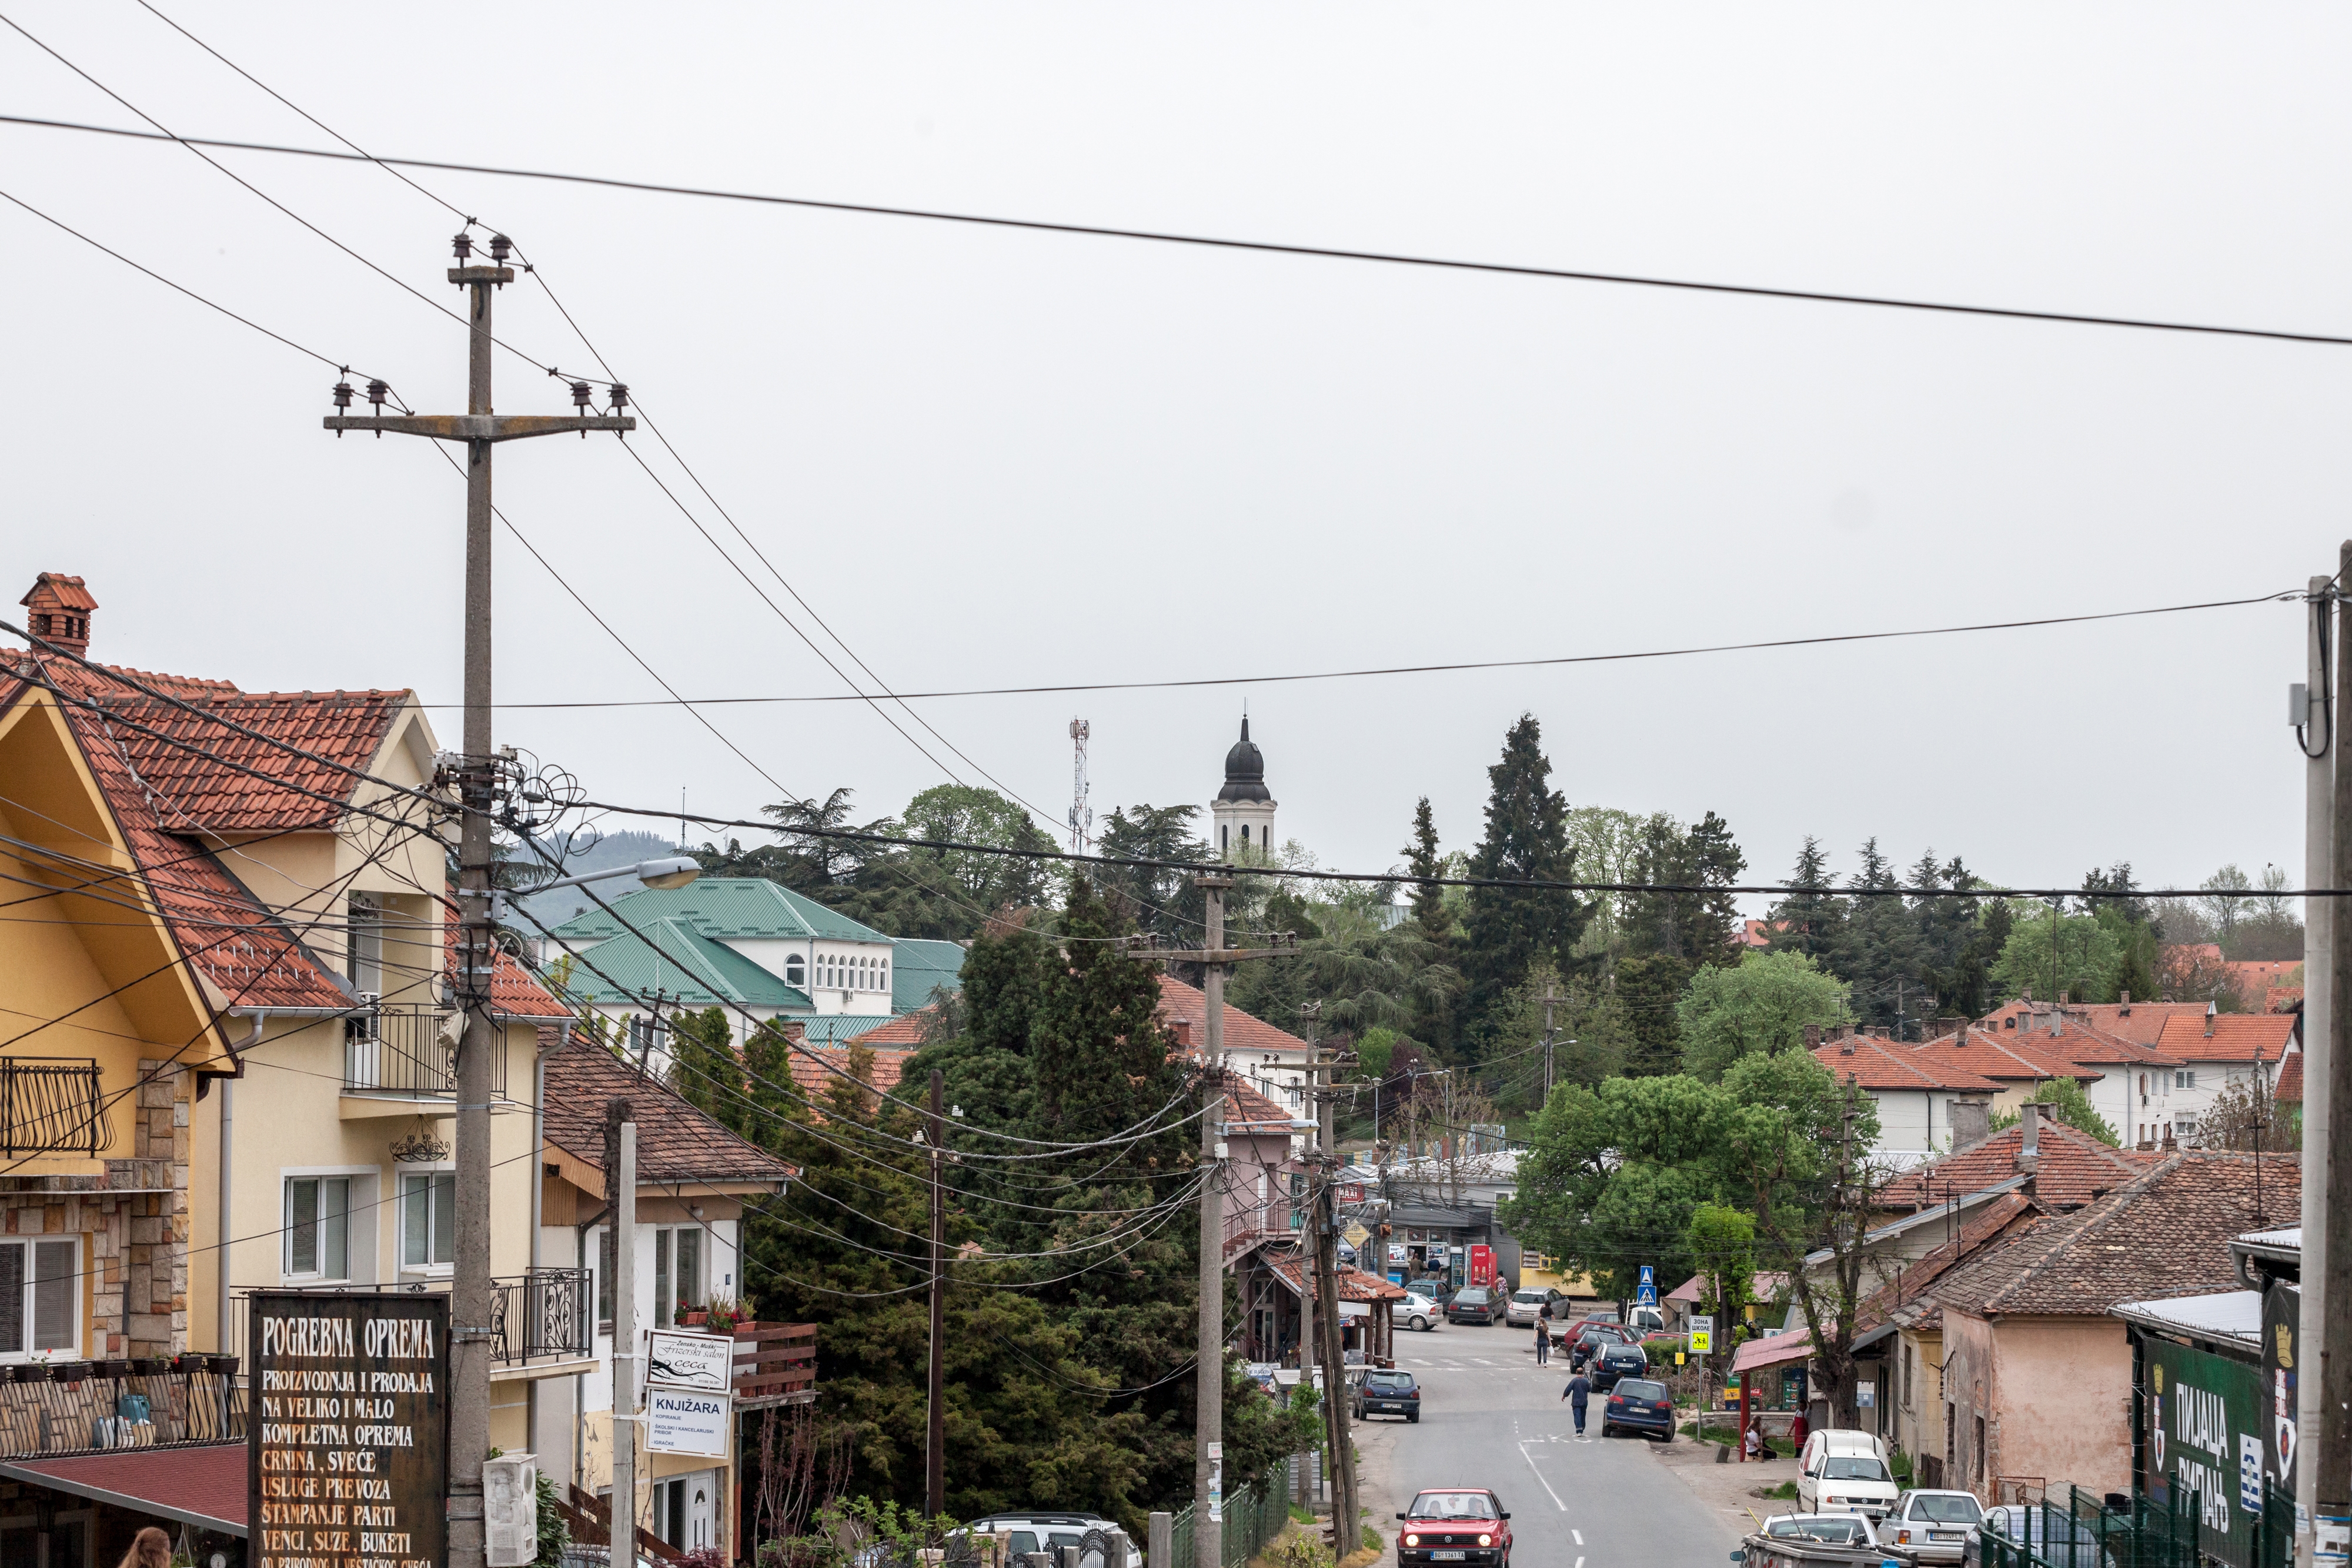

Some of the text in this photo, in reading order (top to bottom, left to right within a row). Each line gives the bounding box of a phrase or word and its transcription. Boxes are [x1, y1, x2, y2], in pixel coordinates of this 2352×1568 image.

[263, 1317, 435, 1359] POGREBNA OPREMA
[657, 1344, 724, 1359] Frizerski salon
[262, 1370, 433, 1393] PROIZVODNJA I PRODAJA
[262, 1397, 395, 1419] NA VELIKO I MALO
[656, 1398, 720, 1415] KNJIŽARA
[262, 1423, 413, 1447] KOMPLETNA OPREMA
[2176, 1382, 2229, 1467] ПИЈАЦА
[328, 1448, 376, 1473] SVEĆE
[262, 1476, 391, 1500] USLUGE PREVOZA
[2178, 1456, 2229, 1534] РИПАЊ
[261, 1503, 396, 1526] ŠTAMPANJE PARTI
[360, 1532, 411, 1553] BUKETI
